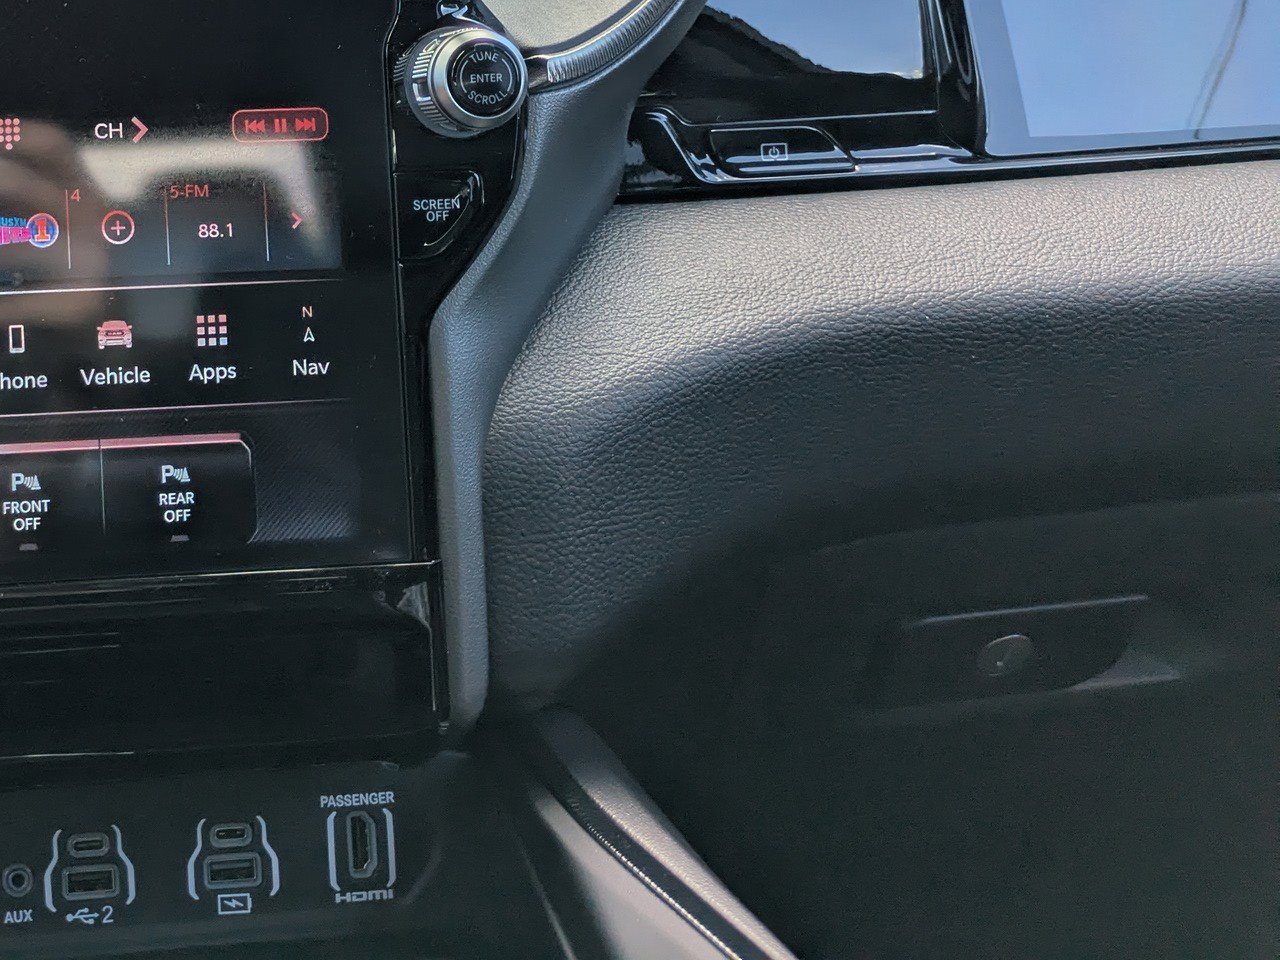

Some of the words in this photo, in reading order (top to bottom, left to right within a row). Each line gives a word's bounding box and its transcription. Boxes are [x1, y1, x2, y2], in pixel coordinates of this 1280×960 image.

[469, 51, 500, 64] TUNE
[470, 73, 503, 84] ENTER
[467, 90, 508, 106] SCROLL
[94, 122, 124, 140] CH
[70, 189, 81, 203] 4
[412, 198, 461, 211] SCREEN
[426, 210, 451, 222] OFF
[34, 217, 51, 242] 1
[198, 223, 234, 238] 88.1
[301, 305, 313, 319] N
[188, 363, 237, 385] Apps
[292, 359, 331, 377] Nav
[80, 365, 151, 387] Vehicle
[158, 491, 195, 506] REAR
[2, 498, 51, 515] FRONT
[163, 508, 192, 523] OFF
[13, 518, 41, 532] OFF
[319, 791, 395, 809] PASSENGER
[3, 908, 34, 924] AUX
[101, 905, 115, 925] 2
